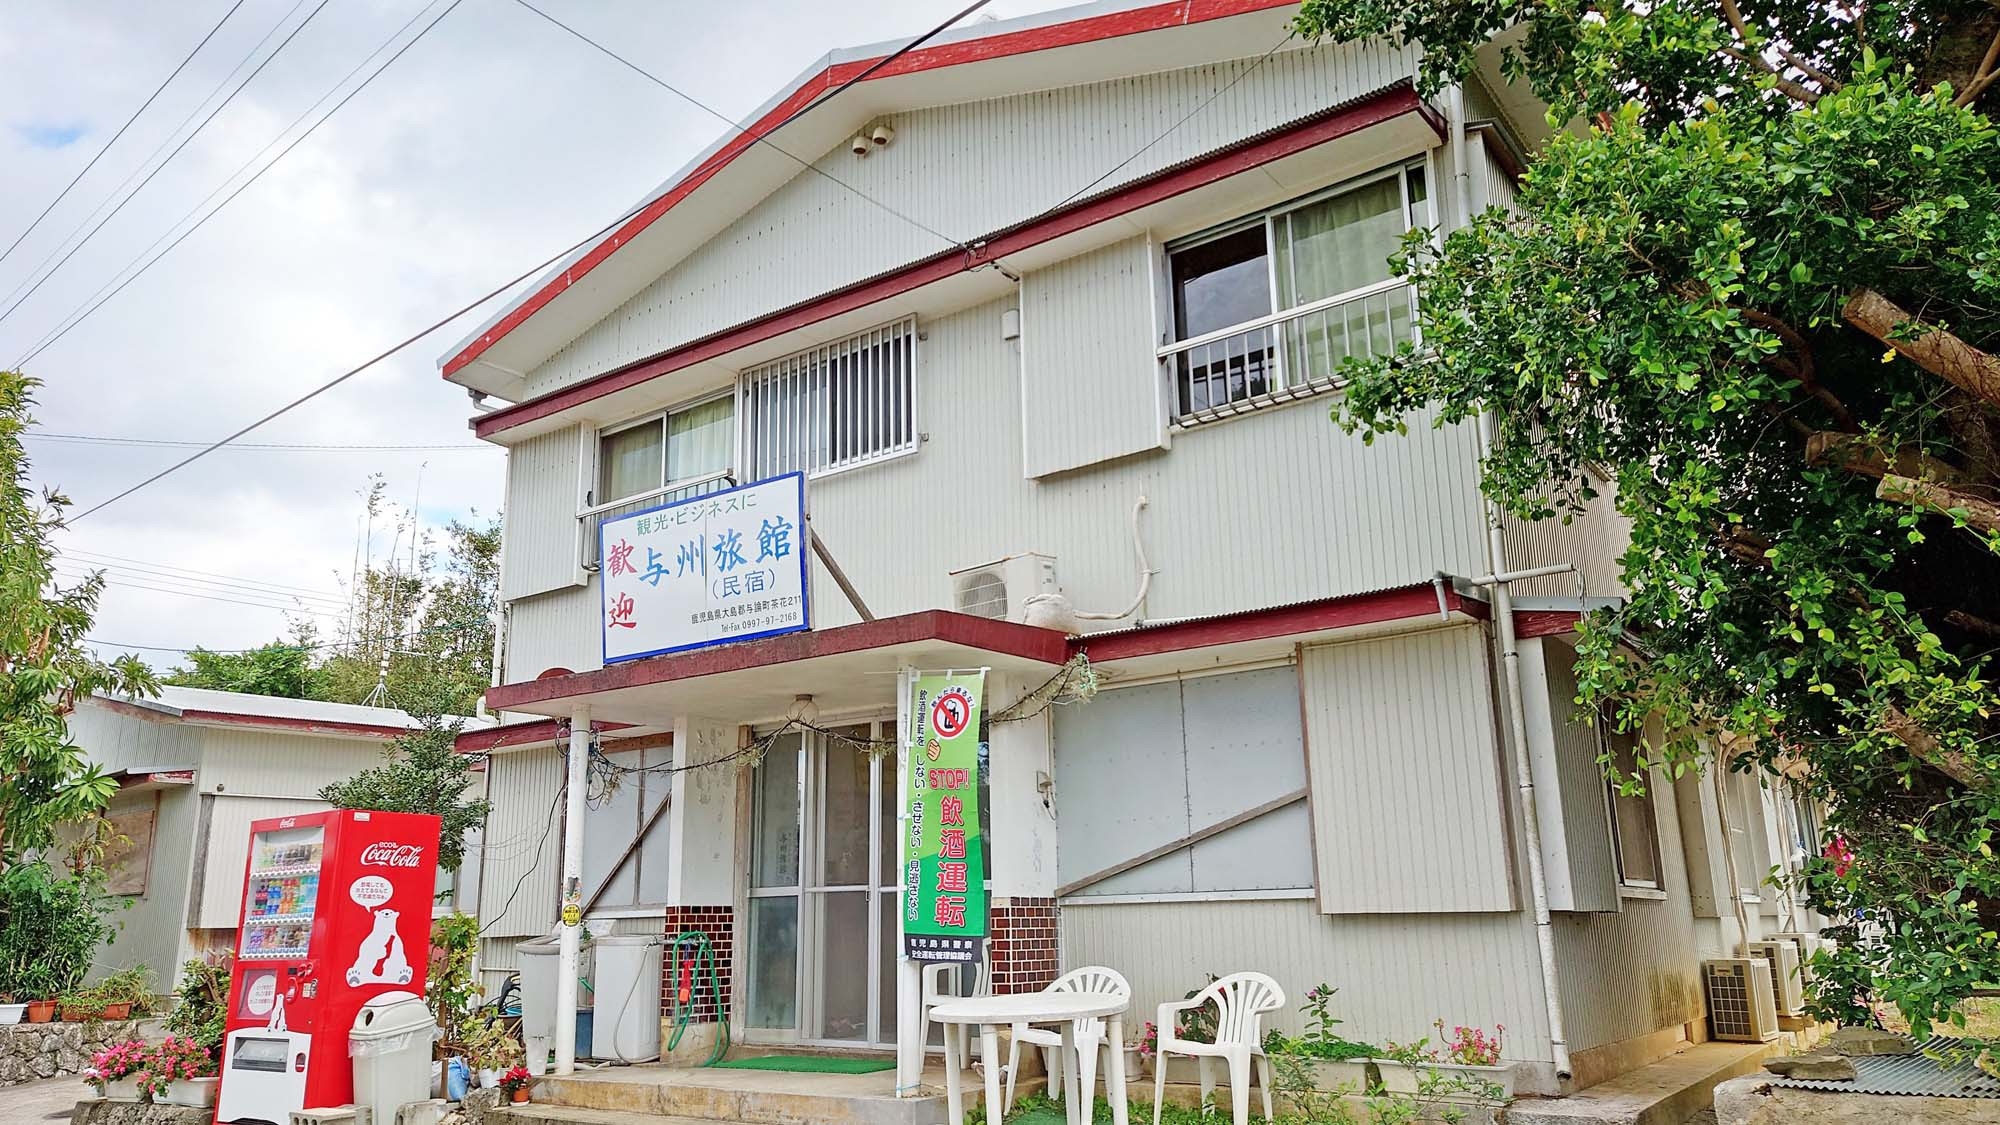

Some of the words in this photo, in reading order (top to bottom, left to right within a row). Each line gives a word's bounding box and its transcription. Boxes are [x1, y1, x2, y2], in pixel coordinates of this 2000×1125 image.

[639, 515, 794, 587] 与州旅館
[607, 538, 638, 629] 歓迎
[742, 612, 798, 630] 0997-97-2168
[928, 768, 970, 790] STOP!
[360, 843, 425, 868] Coca-Cola
[935, 795, 967, 928] 飲酒運転
